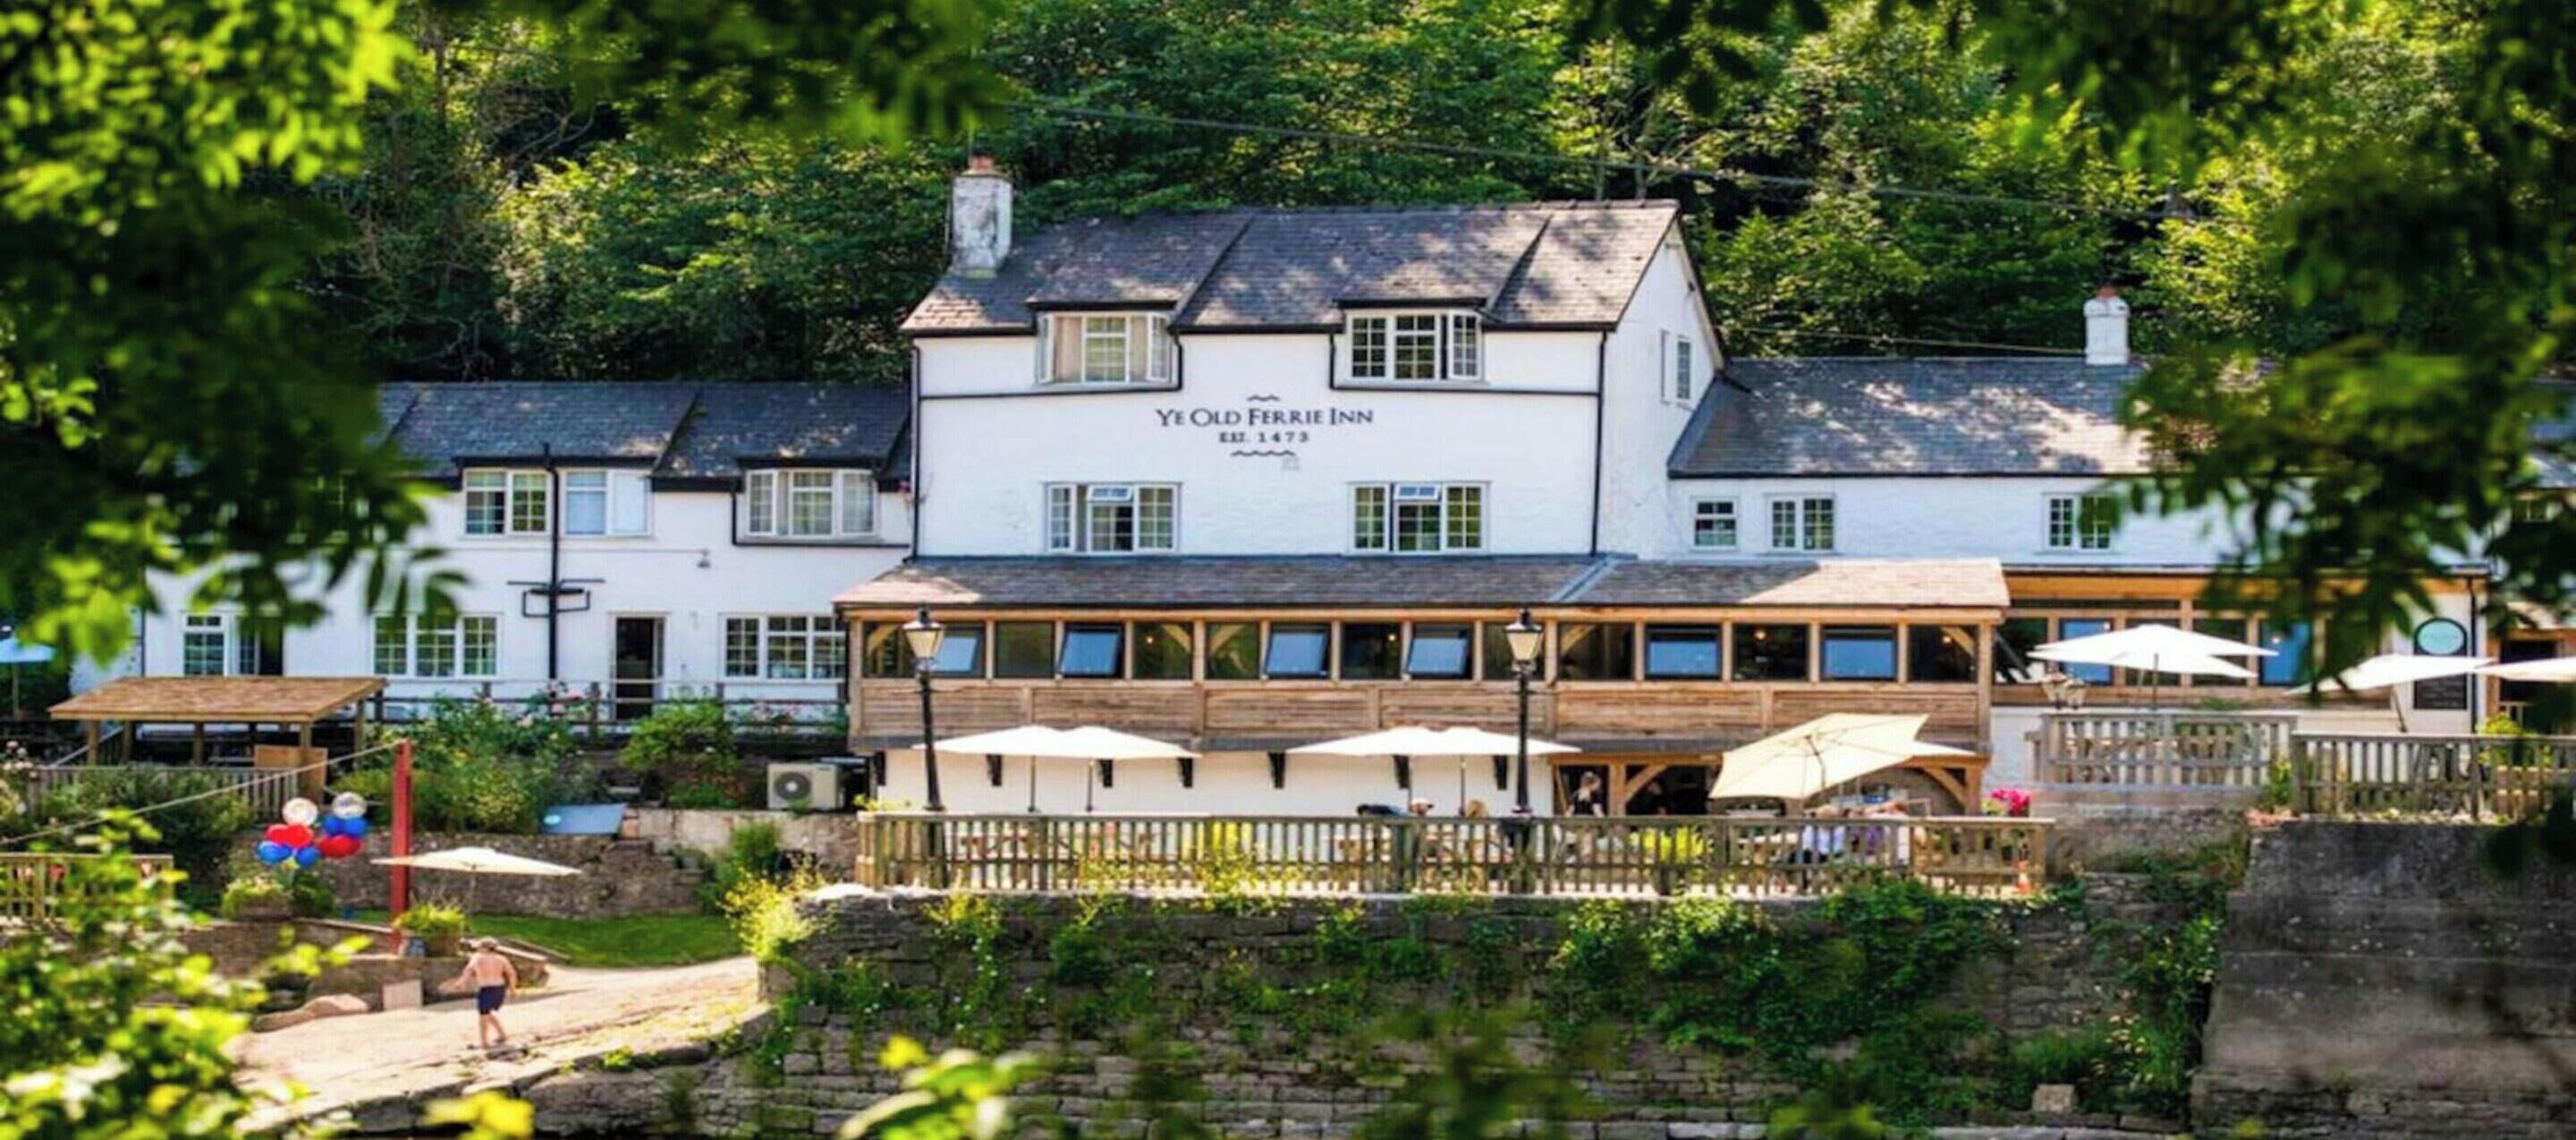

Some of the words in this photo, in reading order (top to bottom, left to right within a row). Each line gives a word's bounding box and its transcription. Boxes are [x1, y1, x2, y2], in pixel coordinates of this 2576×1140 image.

[1157, 409, 1184, 427] YE
[1191, 408, 1242, 427] OLD
[1249, 408, 1324, 426] FERRIE
[1330, 407, 1373, 425] INN
[1258, 431, 1309, 443] 1473
